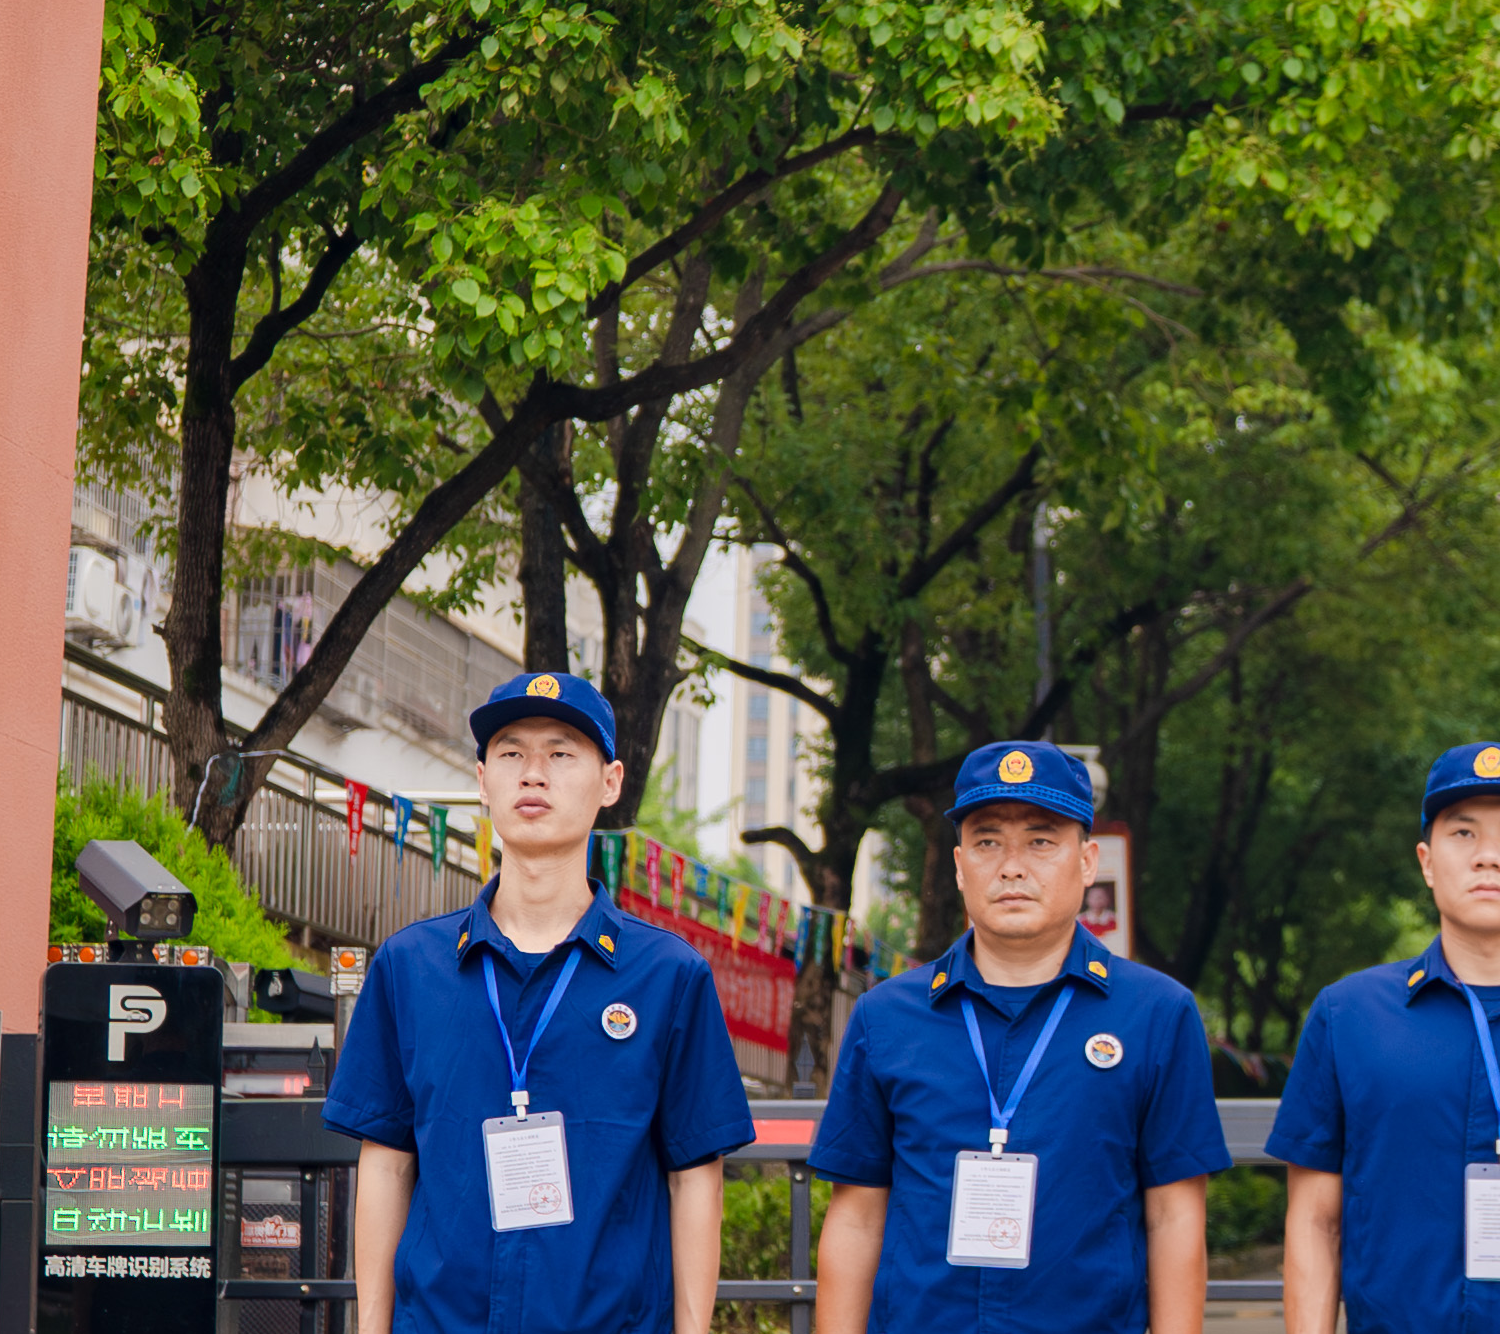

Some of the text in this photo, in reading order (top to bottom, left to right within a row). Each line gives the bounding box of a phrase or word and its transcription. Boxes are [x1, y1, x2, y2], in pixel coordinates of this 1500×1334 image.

[44, 1254, 212, 1279] 高清车牌识别系统
